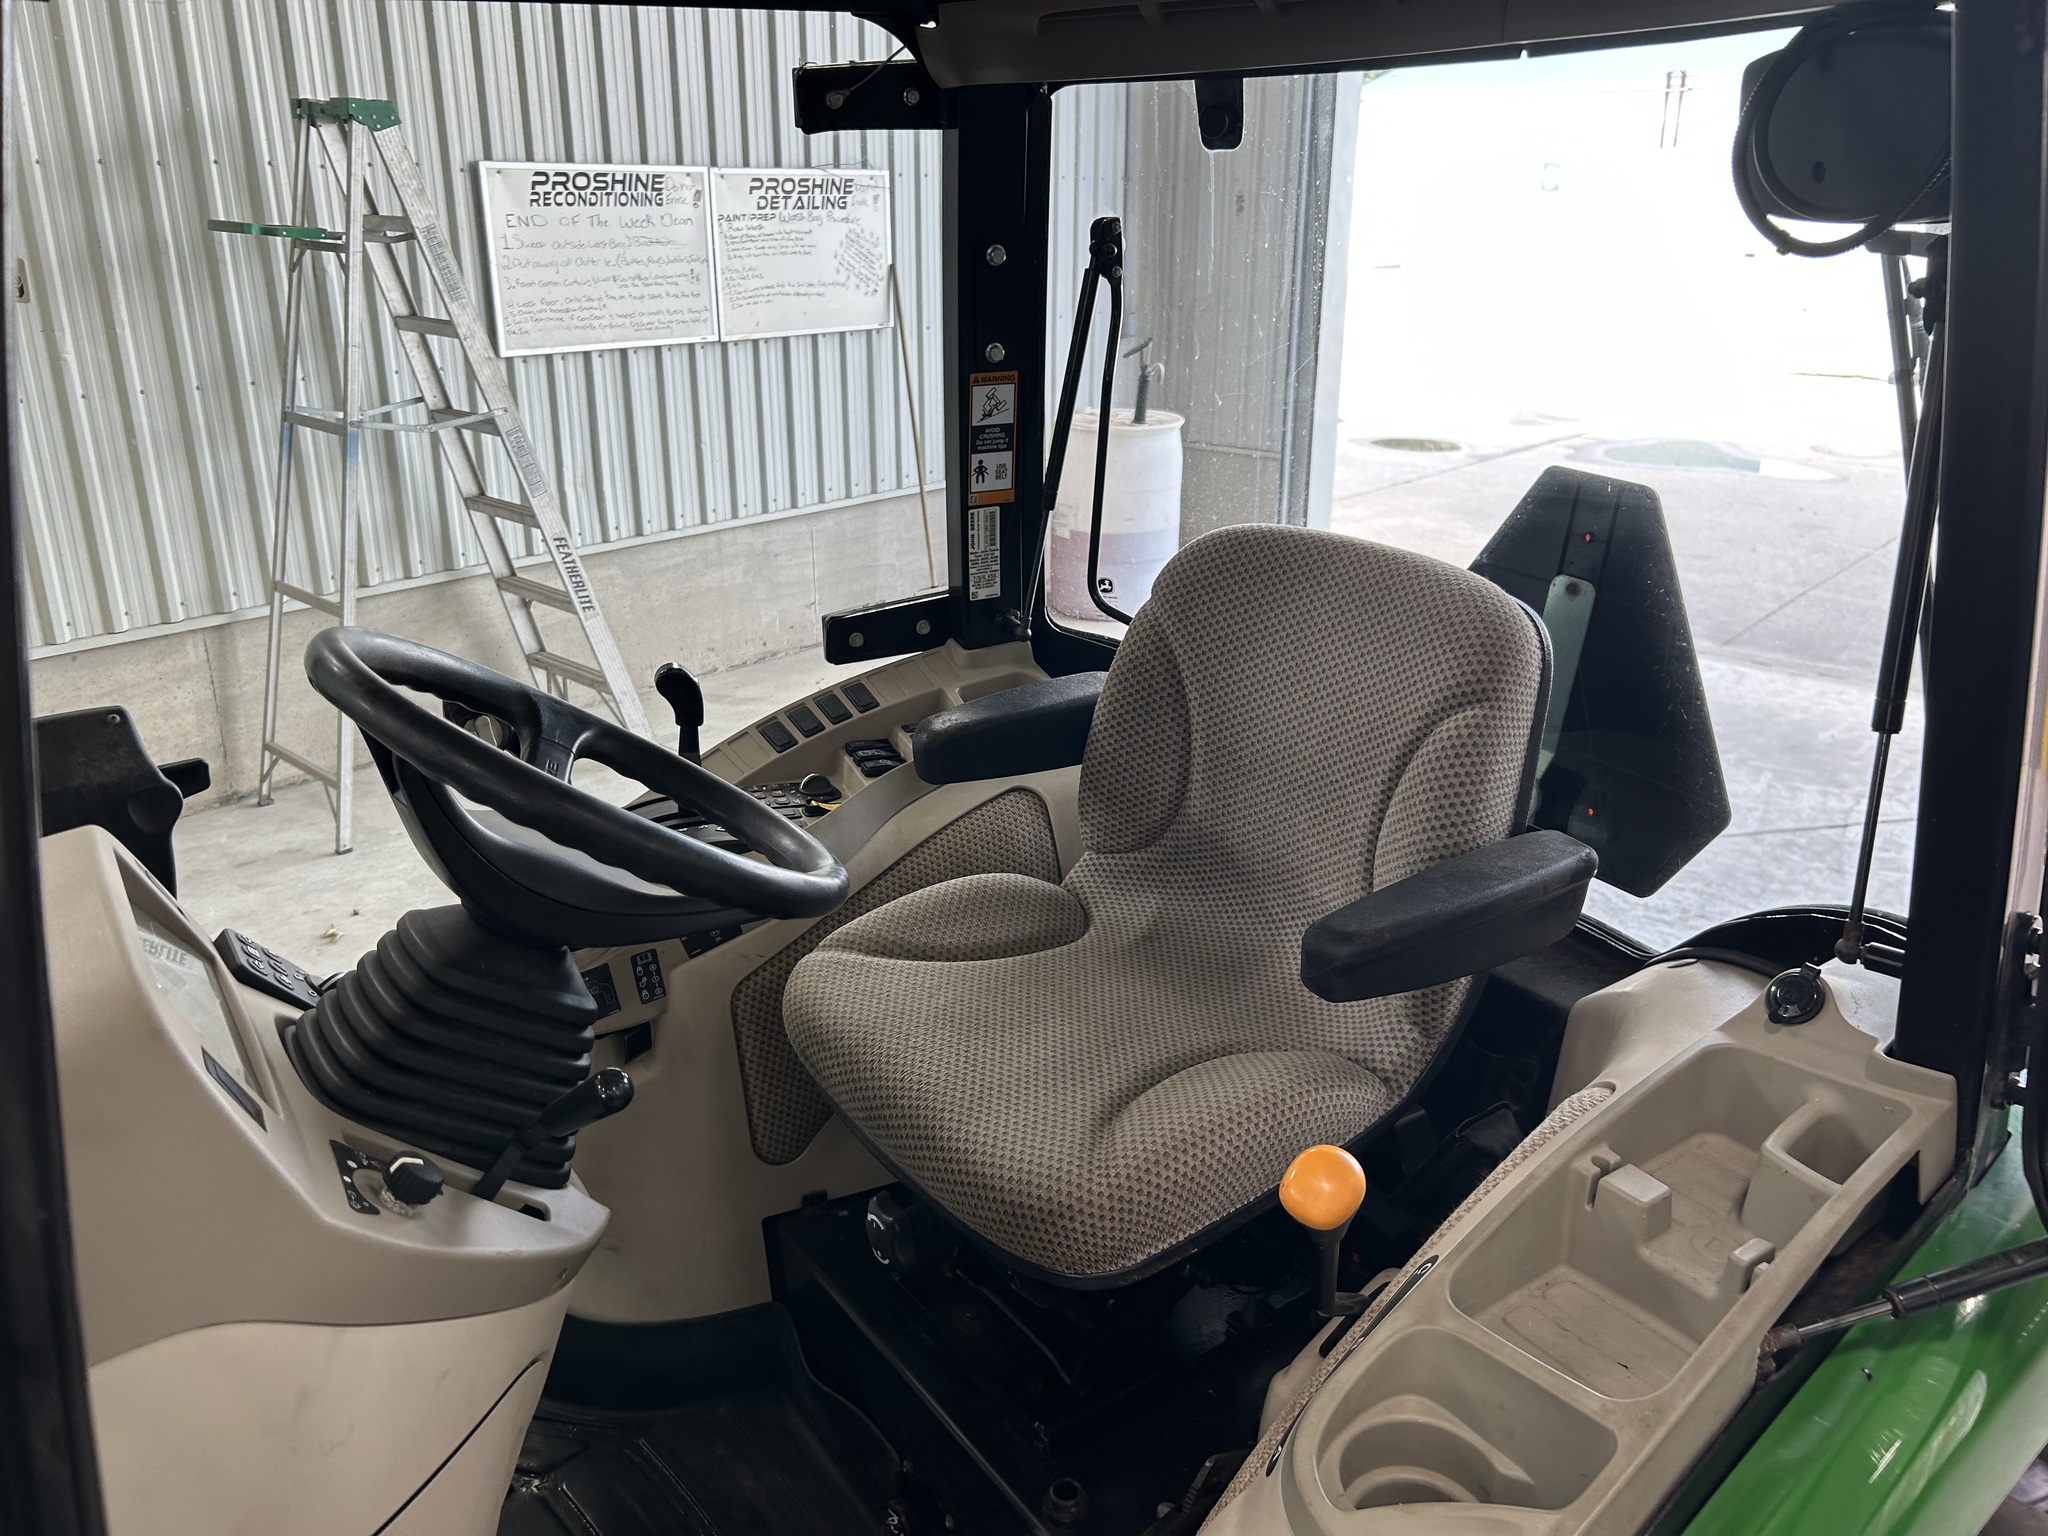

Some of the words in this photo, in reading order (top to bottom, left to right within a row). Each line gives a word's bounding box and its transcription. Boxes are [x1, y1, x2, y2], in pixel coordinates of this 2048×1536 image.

[531, 171, 666, 192] PROSHINE
[749, 177, 856, 195] PROSHINE
[529, 191, 665, 207] RECONDITIONING
[757, 195, 848, 211] DETAILING
[505, 213, 549, 228] END
[980, 374, 1016, 384] WARNING
[553, 537, 596, 613] FEATHERLITE
